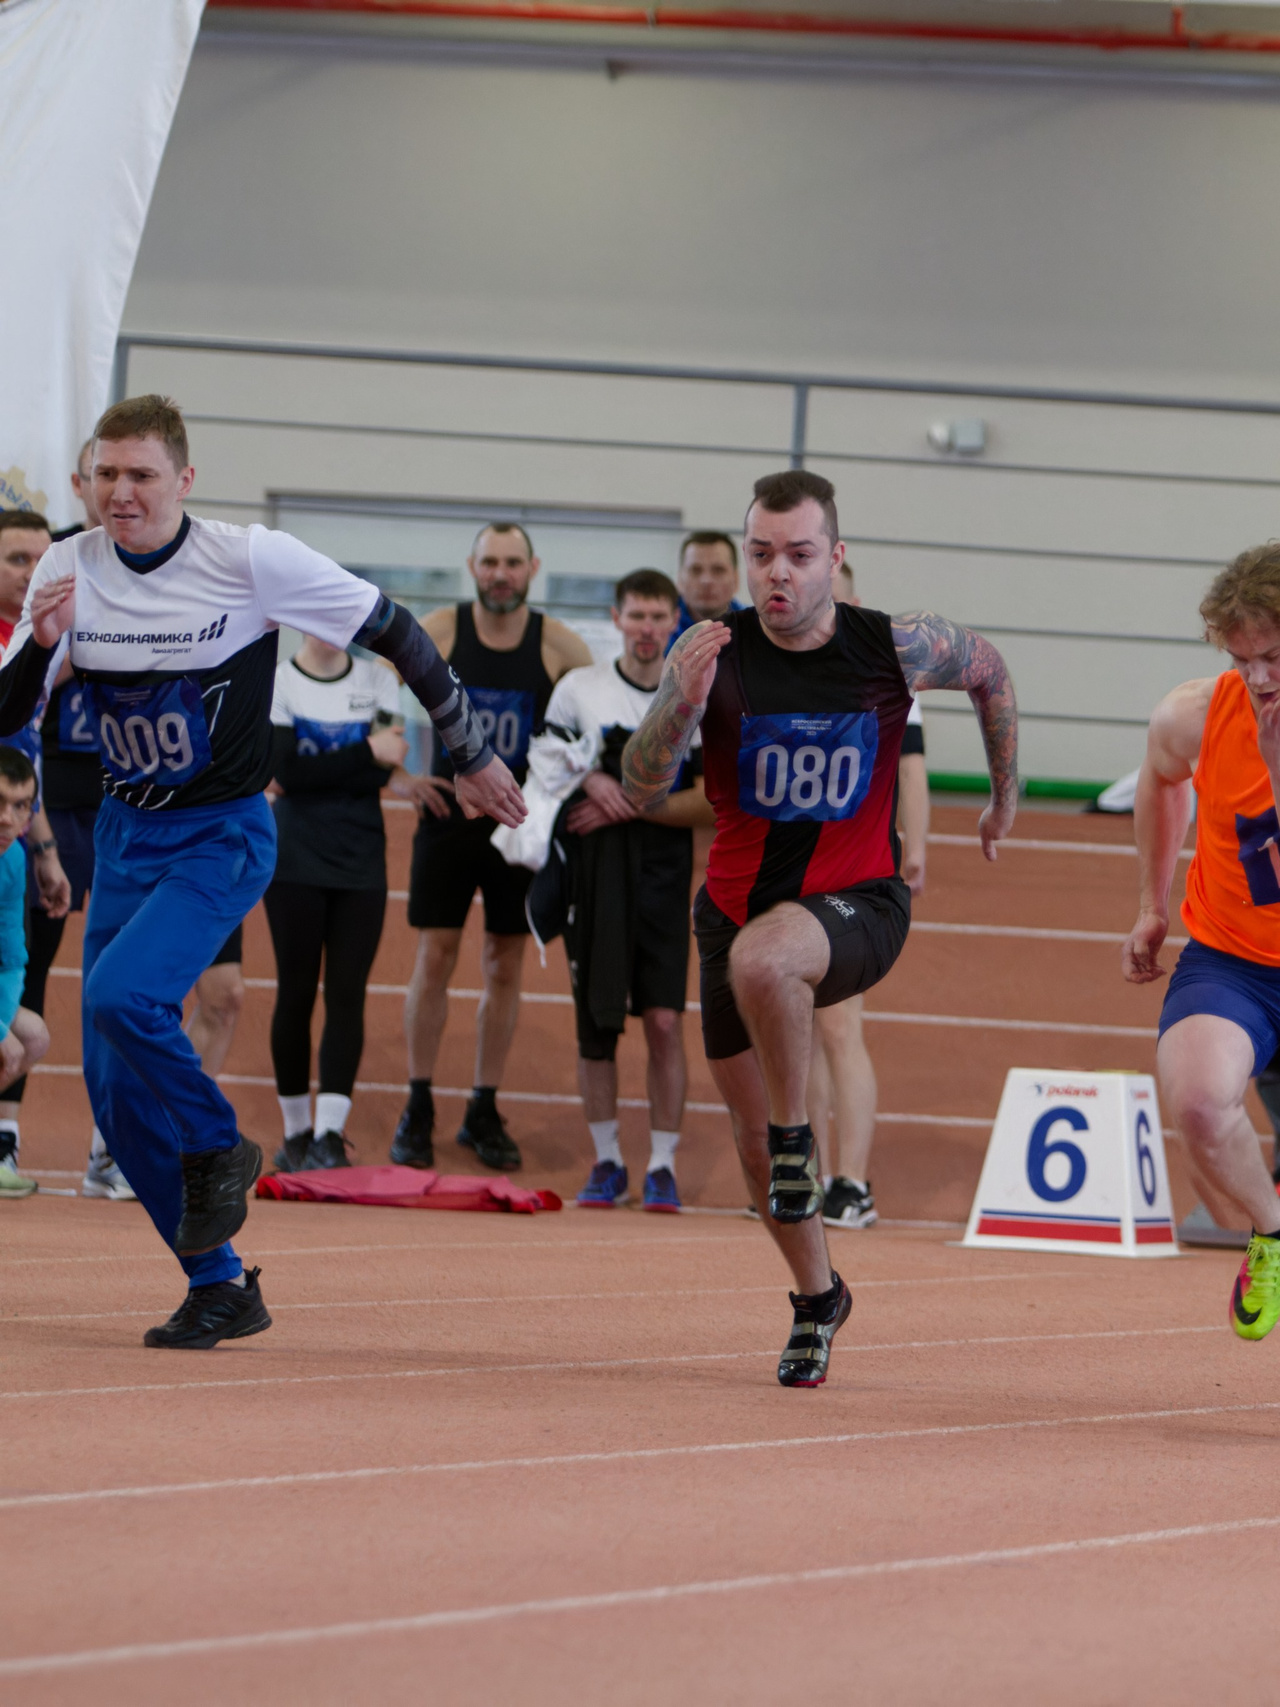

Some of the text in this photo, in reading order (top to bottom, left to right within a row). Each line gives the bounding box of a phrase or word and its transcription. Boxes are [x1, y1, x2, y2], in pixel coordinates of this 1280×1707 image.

[74, 631, 193, 643] ЕХНОДИНАМИКА
[101, 712, 194, 775] 009
[755, 744, 861, 809] 080
[1026, 1106, 1090, 1202] 6
[1135, 1109, 1156, 1207] 6
